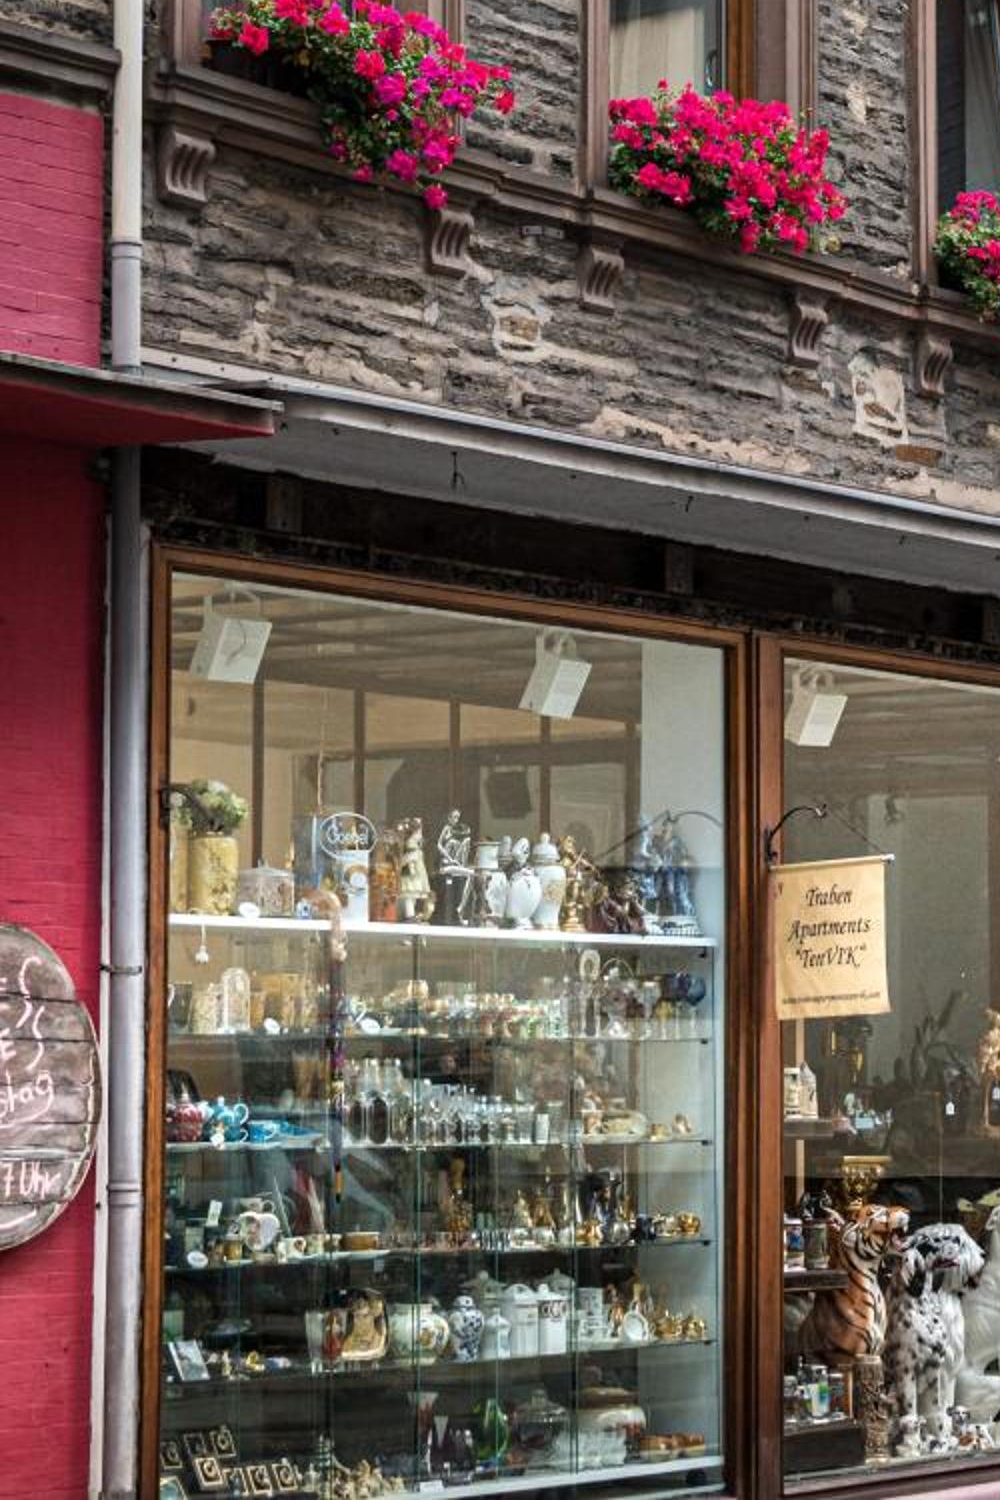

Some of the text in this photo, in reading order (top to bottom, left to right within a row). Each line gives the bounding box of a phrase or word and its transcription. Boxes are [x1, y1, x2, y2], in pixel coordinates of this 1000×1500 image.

[805, 883, 852, 907] Traben
[787, 917, 871, 944] Apartments
[19, 1160, 62, 1200] Uhr
